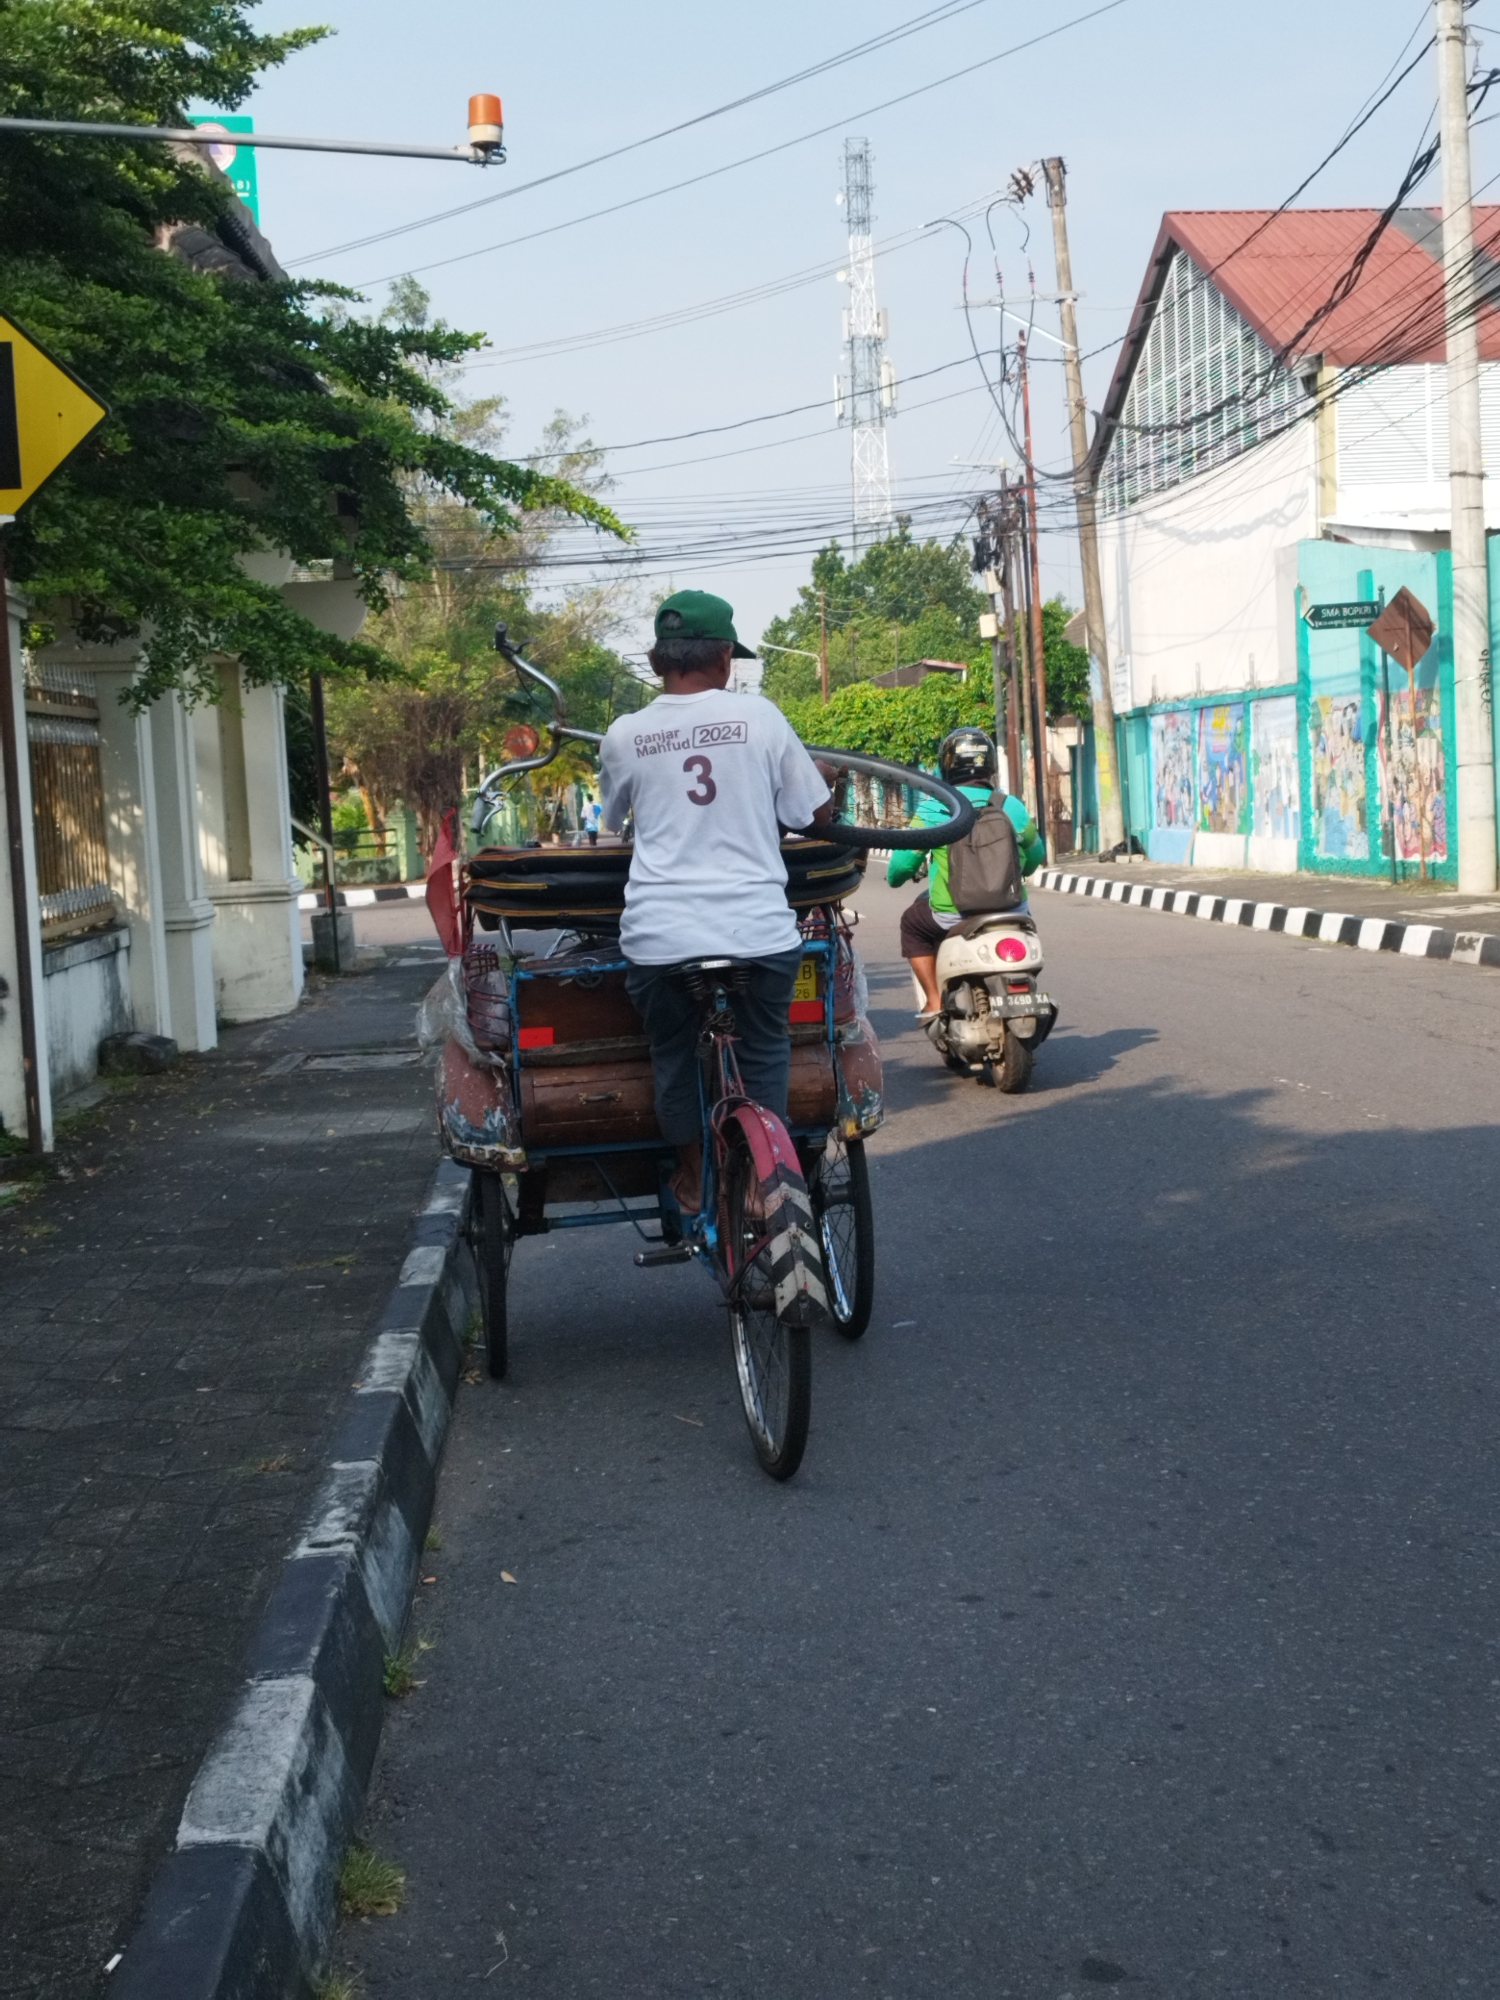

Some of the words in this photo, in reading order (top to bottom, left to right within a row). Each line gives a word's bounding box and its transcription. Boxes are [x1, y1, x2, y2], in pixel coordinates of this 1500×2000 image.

[1321, 606, 1340, 618] SMA
[634, 728, 681, 746] Ganjar
[699, 724, 742, 744] 2024
[636, 738, 691, 758] Mahfud
[682, 754, 717, 806] 3
[988, 996, 1004, 1007] AB
[1035, 993, 1050, 1004] XA
